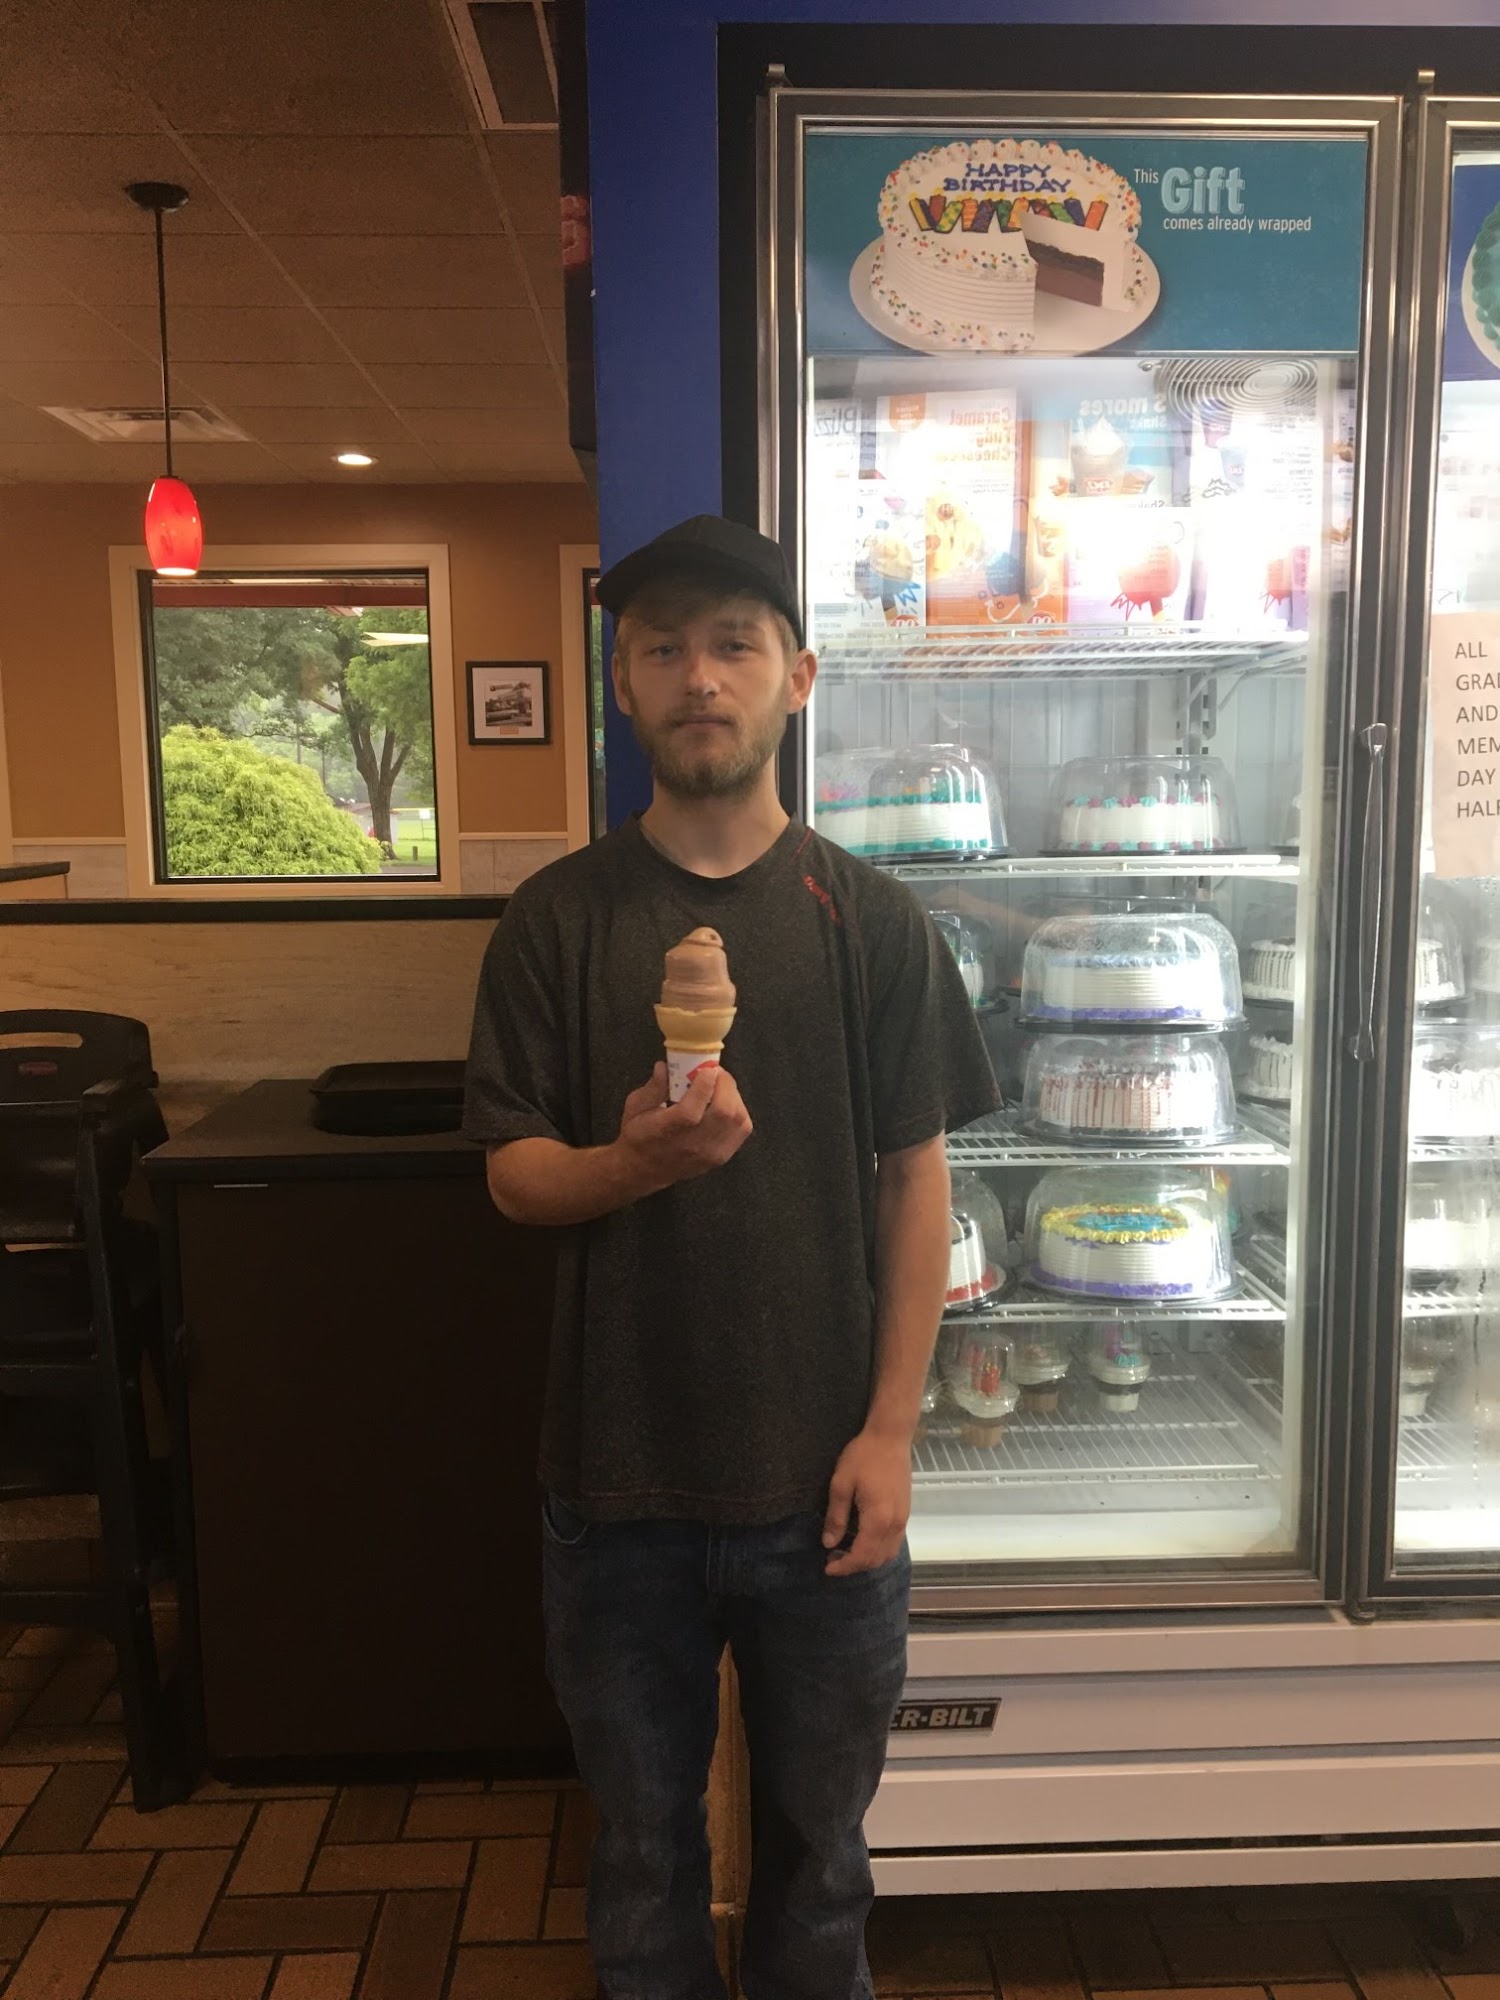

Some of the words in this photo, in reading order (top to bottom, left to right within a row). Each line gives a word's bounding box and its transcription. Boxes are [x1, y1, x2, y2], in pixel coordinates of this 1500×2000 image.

[965, 163, 1051, 178] HAPPY
[943, 177, 1071, 193] BIRTHDAY
[1134, 168, 1159, 184] This
[1161, 166, 1245, 215] Gift
[1163, 217, 1204, 231] comes
[1207, 216, 1254, 234] already
[1258, 216, 1312, 234] wrapped
[1454, 641, 1488, 660] ALL
[1455, 704, 1499, 723] AND
[1457, 768, 1497, 787] DAY
